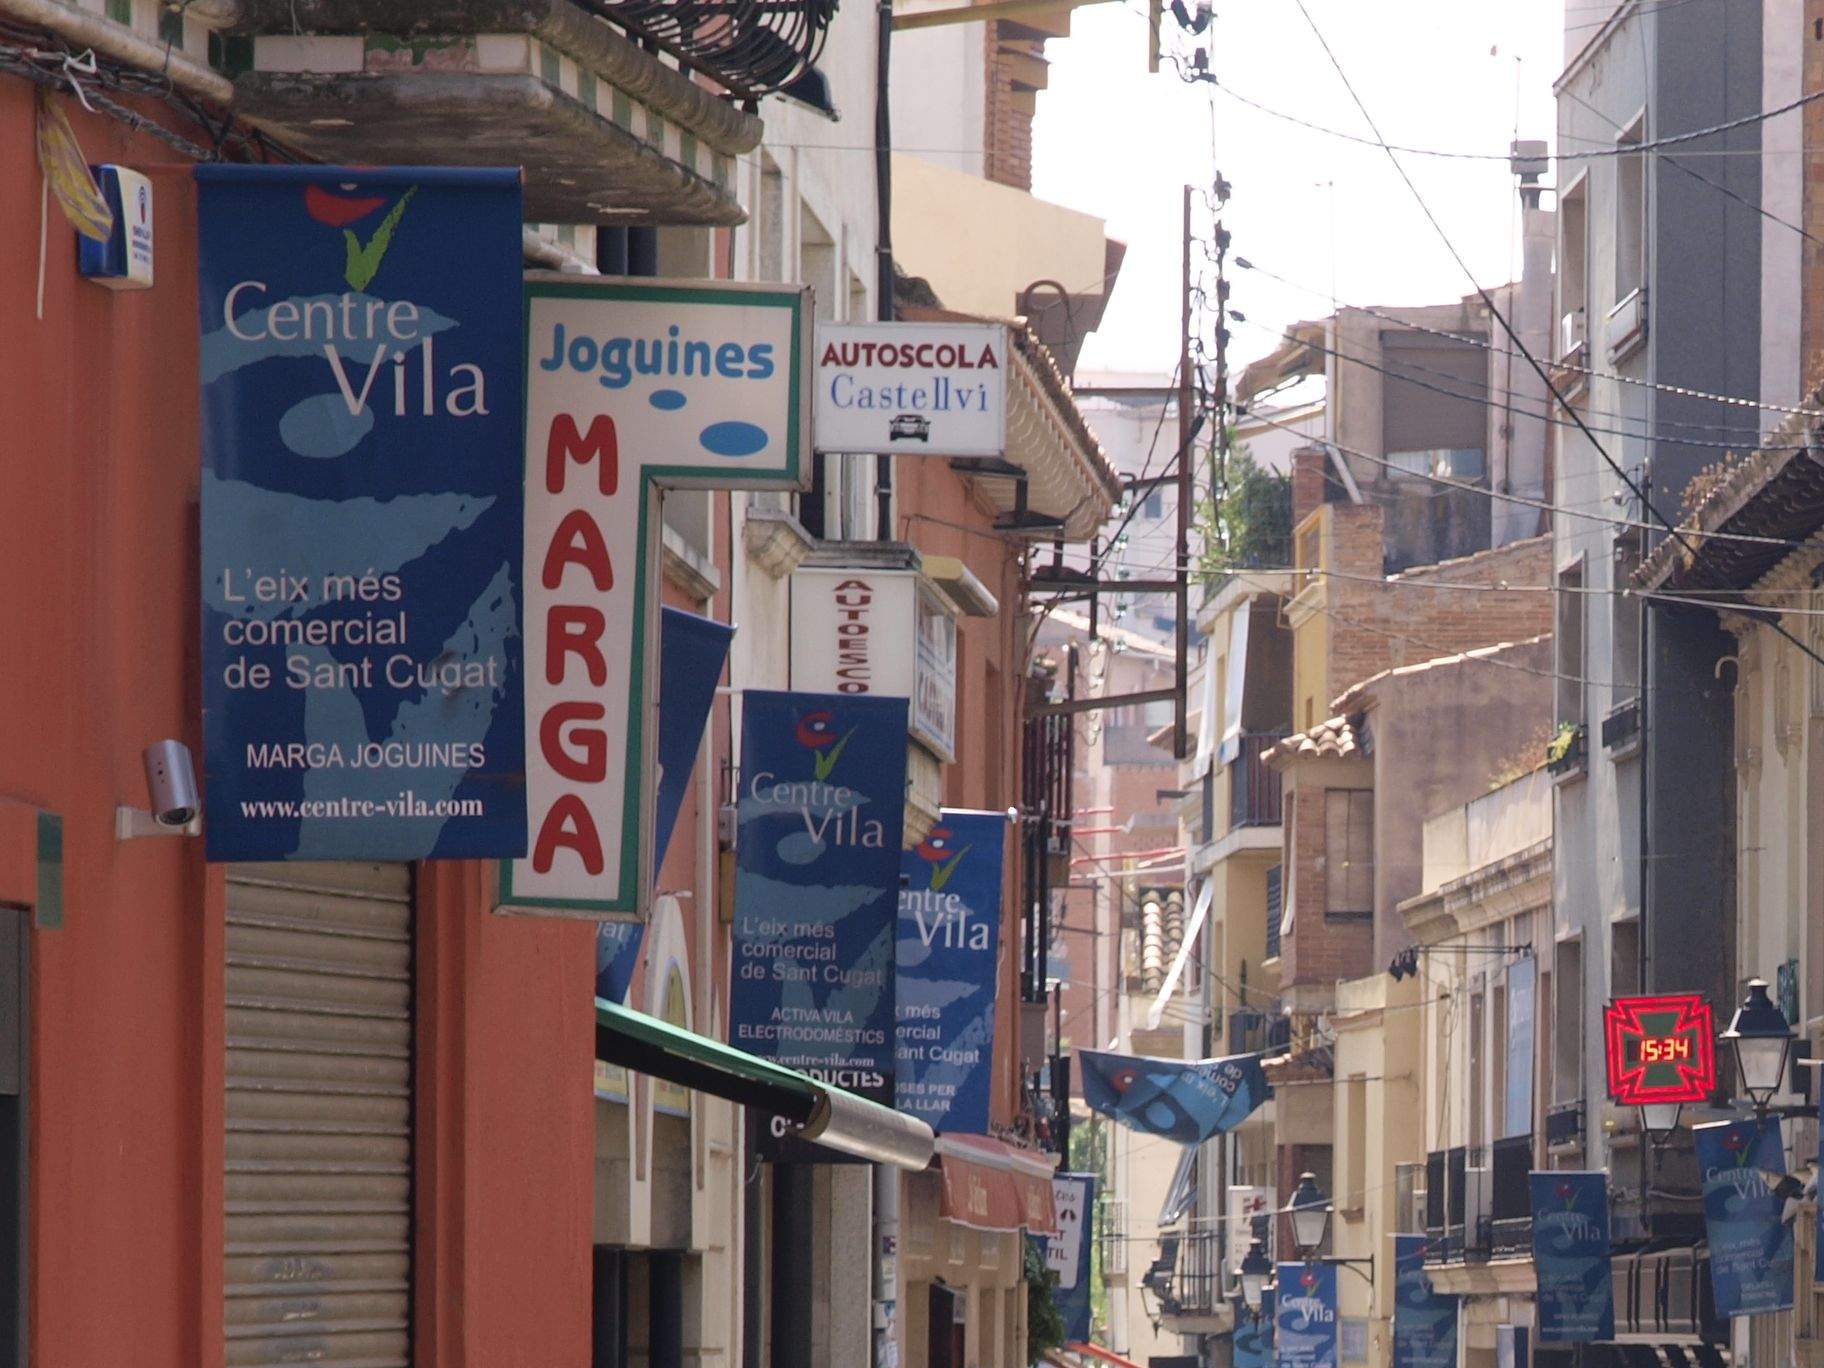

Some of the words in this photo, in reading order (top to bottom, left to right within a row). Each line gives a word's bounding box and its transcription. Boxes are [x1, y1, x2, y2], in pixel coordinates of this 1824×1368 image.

[224, 280, 419, 341] Centre
[540, 322, 775, 390] Joguines
[820, 342, 999, 369] AUTOSCOLA
[323, 336, 490, 416] Vila
[831, 373, 989, 412] Castellvi
[223, 568, 309, 601] L'eix
[323, 567, 402, 601] més
[223, 611, 406, 646] comercial
[532, 412, 619, 876] MARGA
[223, 656, 271, 689] de
[285, 655, 373, 689] Sant
[385, 654, 499, 697] Cugat
[246, 743, 345, 769] MARGA
[350, 743, 486, 769] JOGUINES
[750, 771, 852, 807] Centre
[240, 790, 484, 818] www.centre-vila.com
[801, 804, 884, 848] Vila
[743, 916, 788, 937] L'eix
[793, 920, 835, 938] més
[914, 910, 990, 951] Vila
[742, 941, 836, 962] comercial
[740, 961, 766, 980] de
[772, 962, 817, 983] Sant
[823, 964, 883, 988] Cugat
[770, 1006, 821, 1022] ACTIVA
[823, 1010, 855, 1024] VILA
[905, 1003, 941, 1020] més
[929, 1045, 980, 1067] Cugat
[1640, 1038, 1689, 1062] 15:34
[928, 1083, 957, 1097] PER
[916, 1099, 952, 1113] LLAR
[1561, 1220, 1601, 1242] Vila
[1300, 1302, 1334, 1322] Vila
